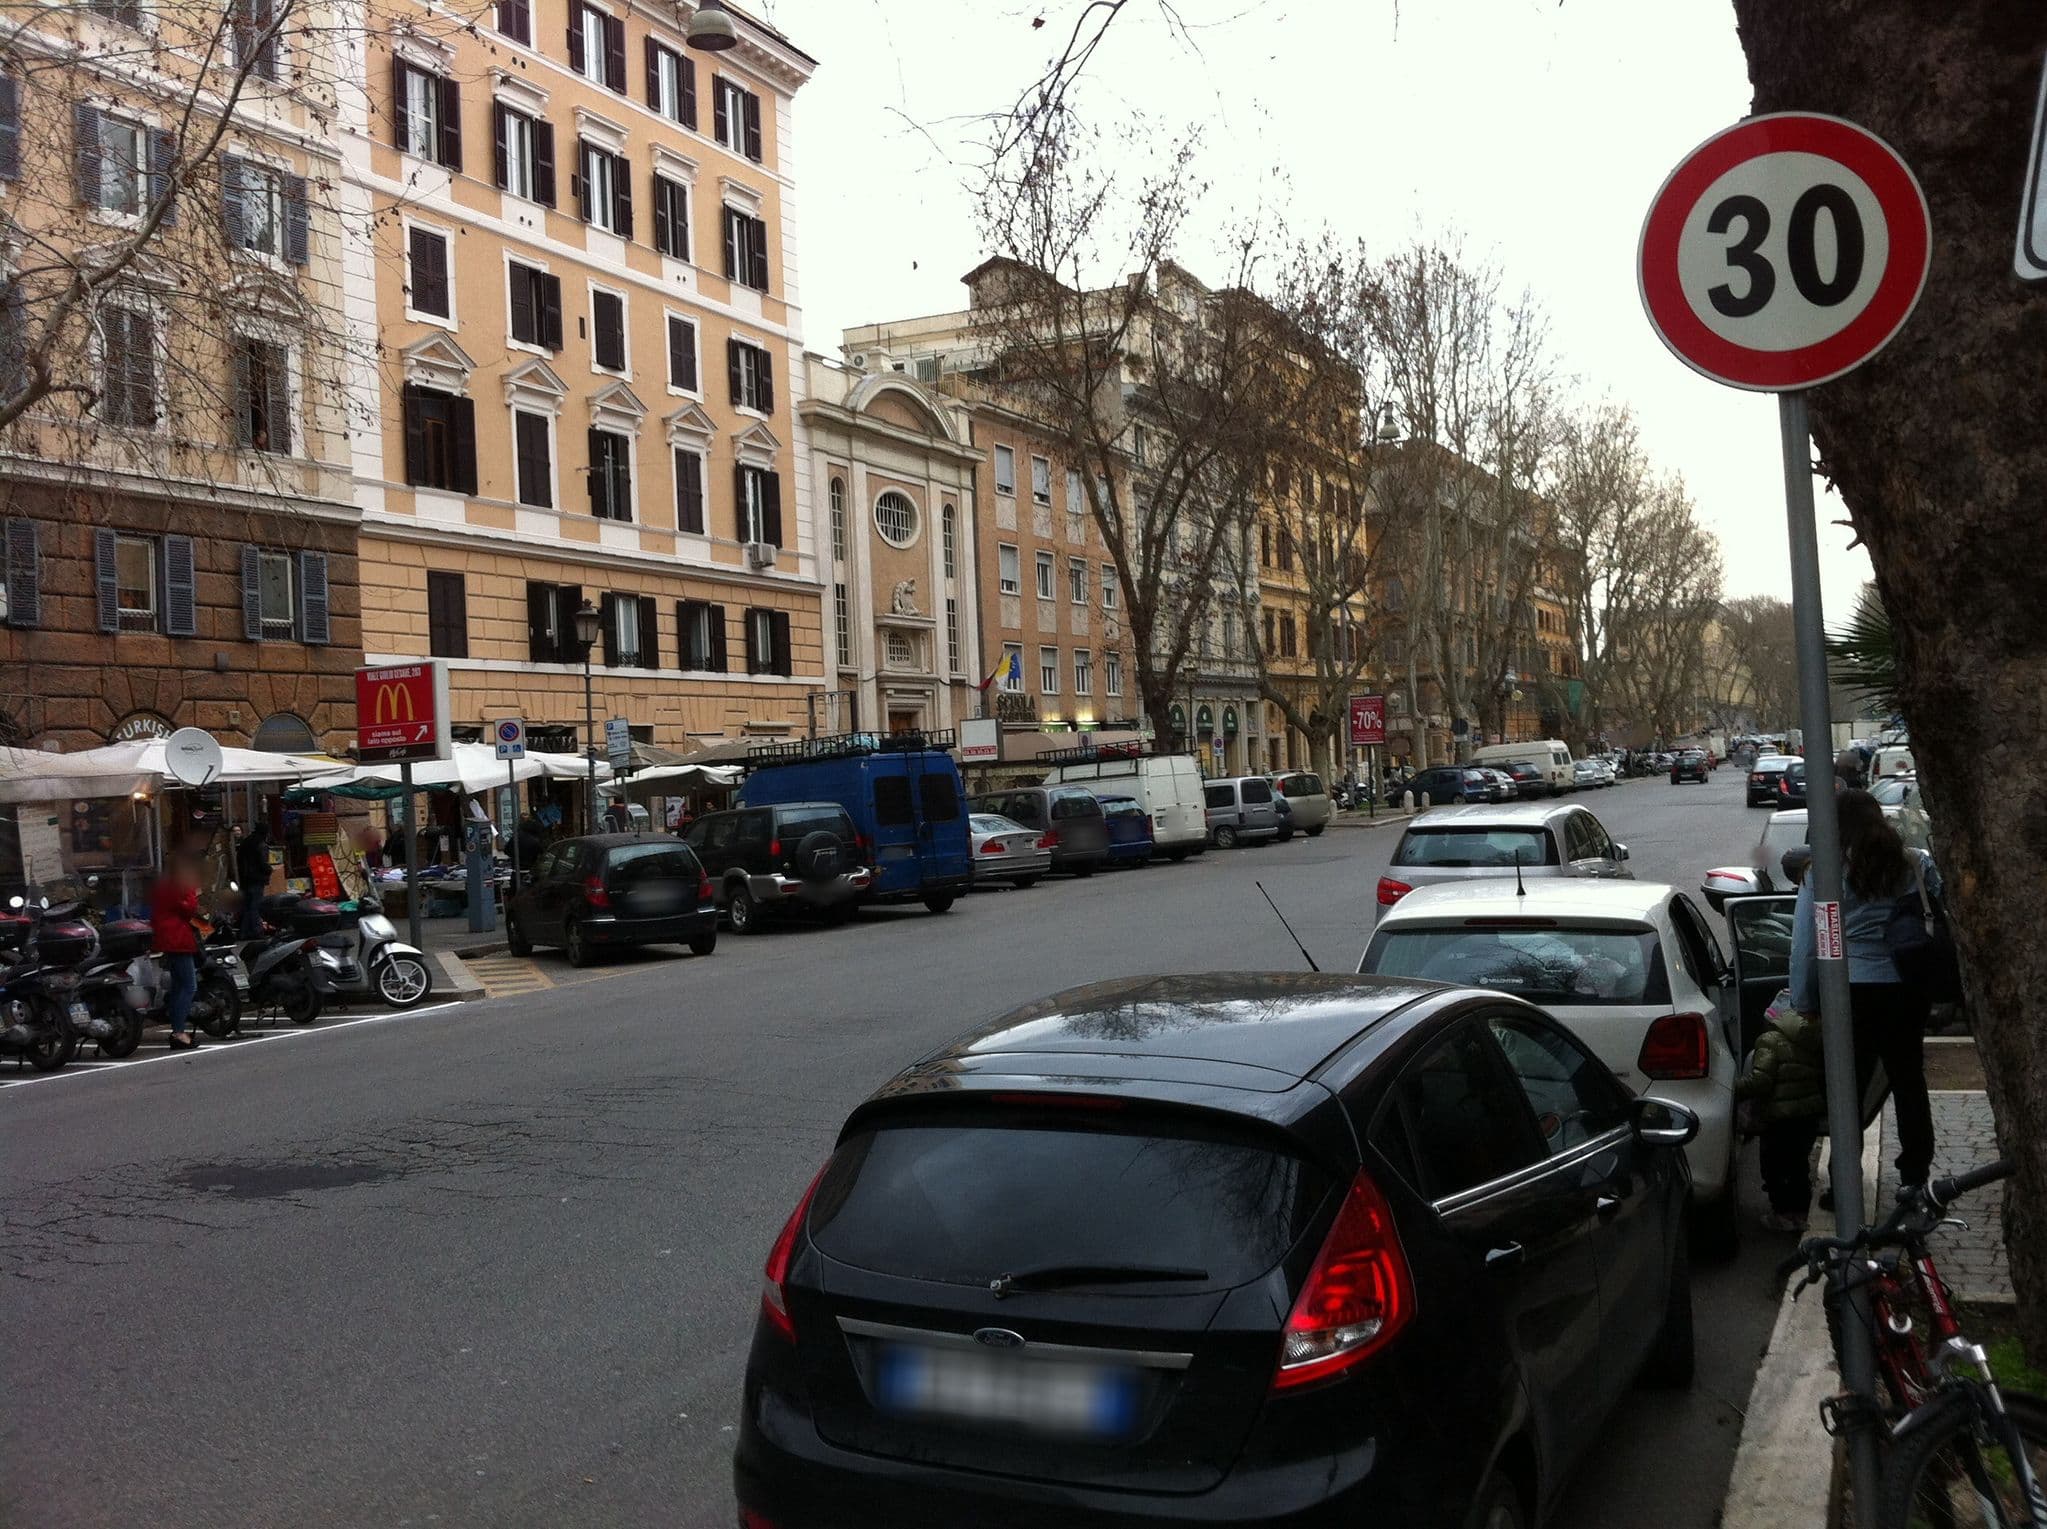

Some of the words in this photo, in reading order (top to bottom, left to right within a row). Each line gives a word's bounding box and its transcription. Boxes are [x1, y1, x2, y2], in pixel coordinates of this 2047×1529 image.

[1707, 183, 1865, 318] 30
[996, 694, 1036, 711] SCUOLA
[1352, 711, 1382, 729] -70%
[1829, 905, 1841, 957] TRASLOCHI
